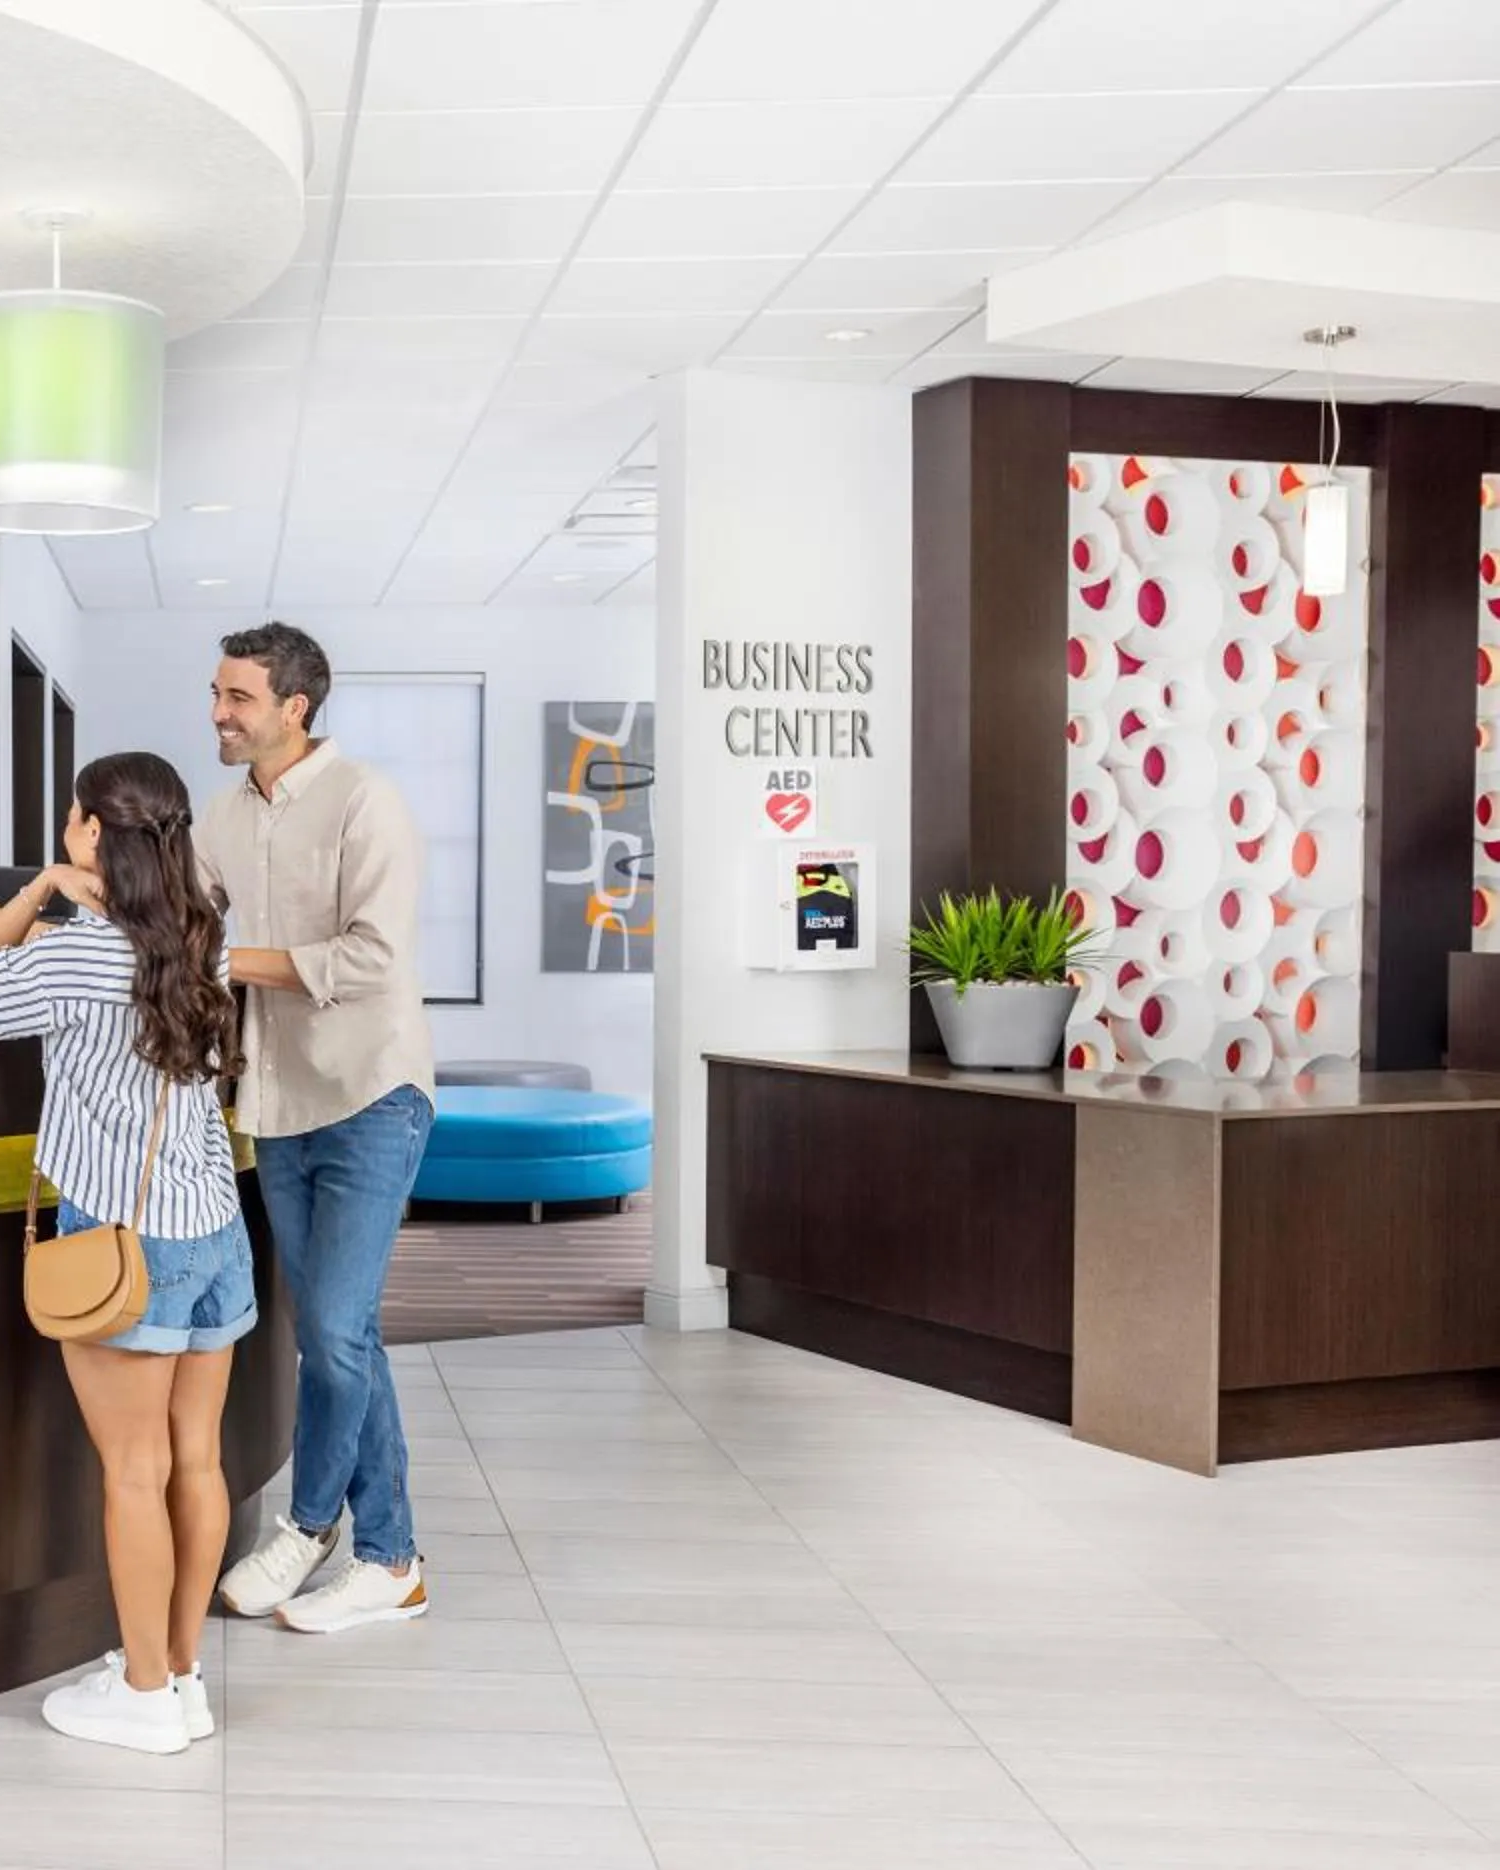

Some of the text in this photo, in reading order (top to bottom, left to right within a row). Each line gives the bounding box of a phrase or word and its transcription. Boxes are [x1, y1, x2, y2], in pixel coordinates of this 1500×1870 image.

[703, 639, 874, 695] BUSINESS
[725, 705, 874, 759] CENTER
[765, 769, 812, 791] AED
